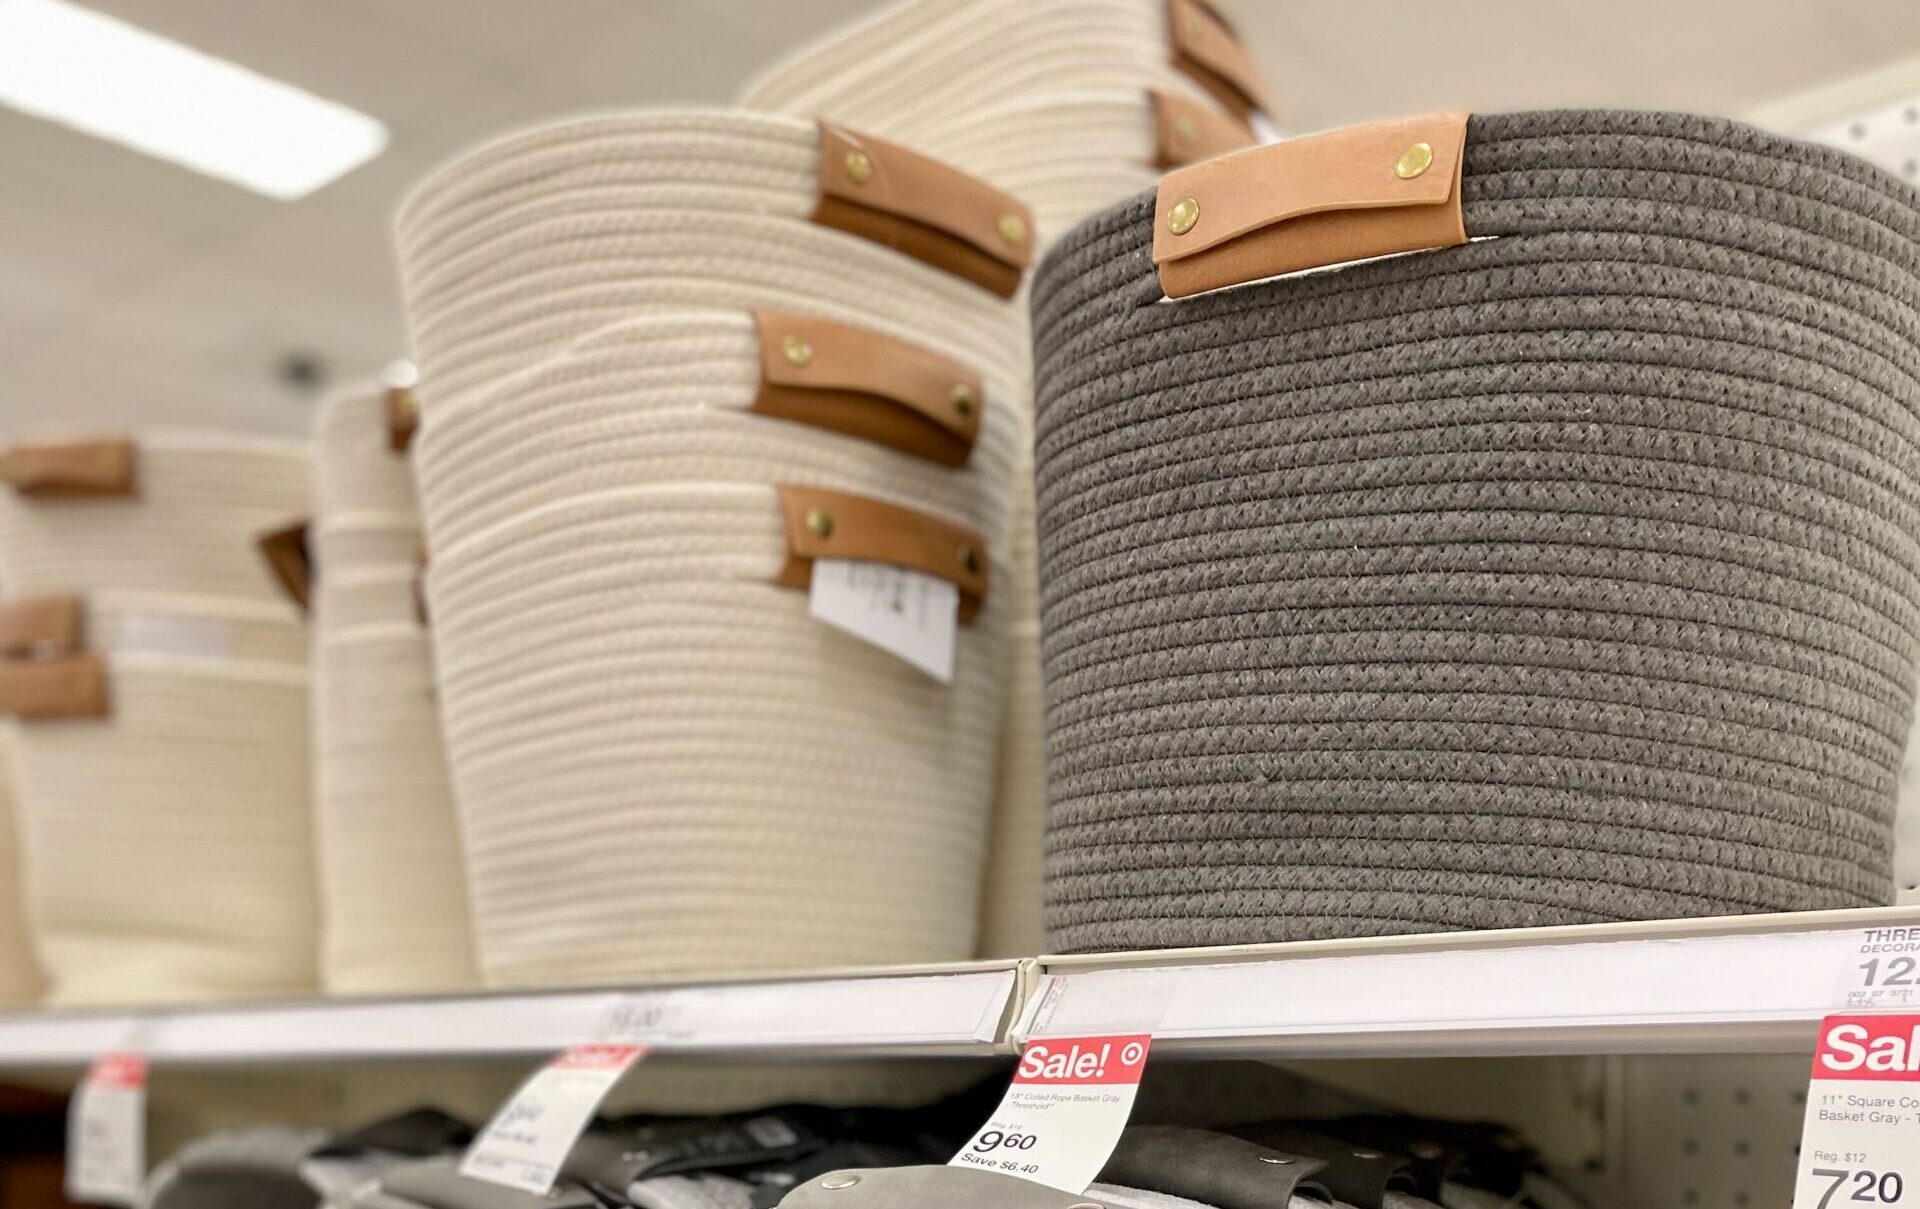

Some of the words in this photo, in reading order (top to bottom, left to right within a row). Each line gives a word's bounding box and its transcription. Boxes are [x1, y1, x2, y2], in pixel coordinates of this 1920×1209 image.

[1820, 1023, 1920, 1072] Sal
[1018, 1043, 1111, 1079] Sale!
[1025, 1092, 1049, 1101] Coiled
[1051, 1093, 1071, 1102] Rope
[1073, 1094, 1100, 1102] Basket
[1102, 1094, 1120, 1103] Gray
[1822, 1094, 1843, 1105] 11"
[1847, 1094, 1895, 1108] Square
[1818, 1109, 1864, 1122] Basket
[1869, 1111, 1901, 1126] Gray
[961, 1153, 997, 1167] Save
[1000, 1160, 1039, 1174] $6.40
[1814, 1150, 1840, 1163] Reg.
[1844, 1152, 1867, 1163] $12
